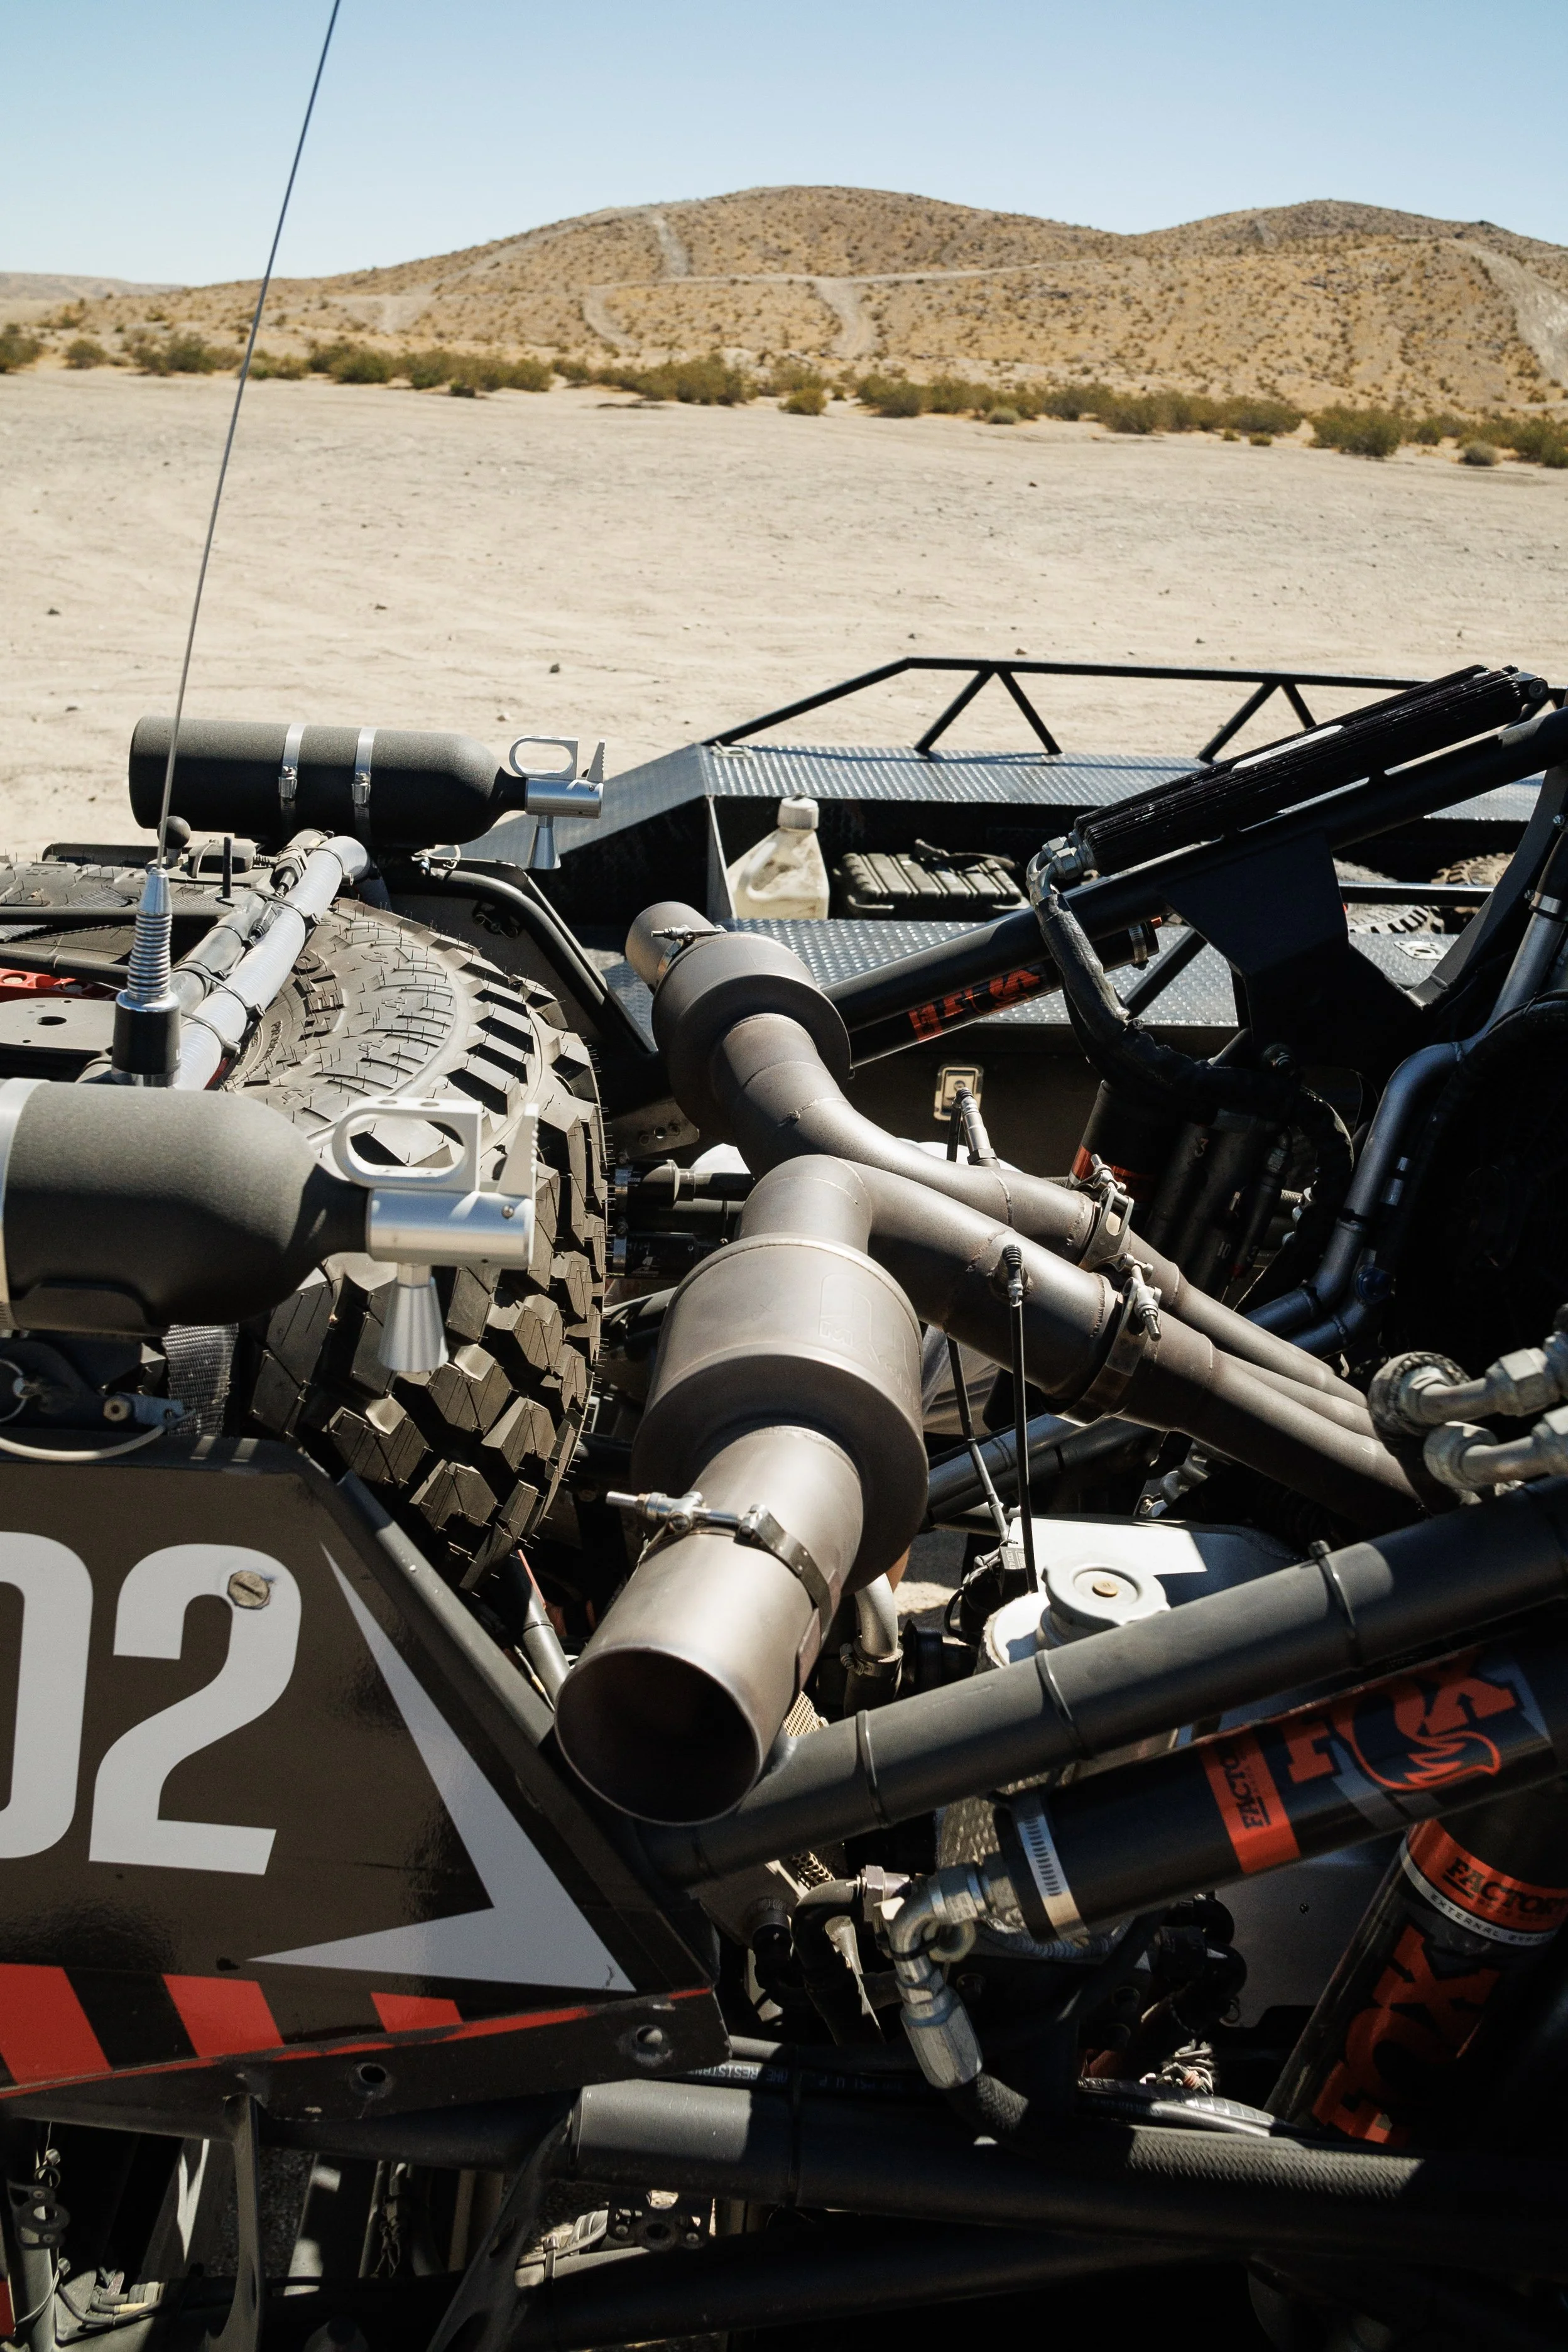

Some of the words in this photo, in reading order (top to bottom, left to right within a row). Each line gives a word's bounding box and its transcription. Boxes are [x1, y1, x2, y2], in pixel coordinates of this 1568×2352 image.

[1280, 1643, 1518, 1790] FOX
[1430, 1893, 1500, 1938] EXTERNAL
[687, 2065, 760, 2081] RESISTAN
